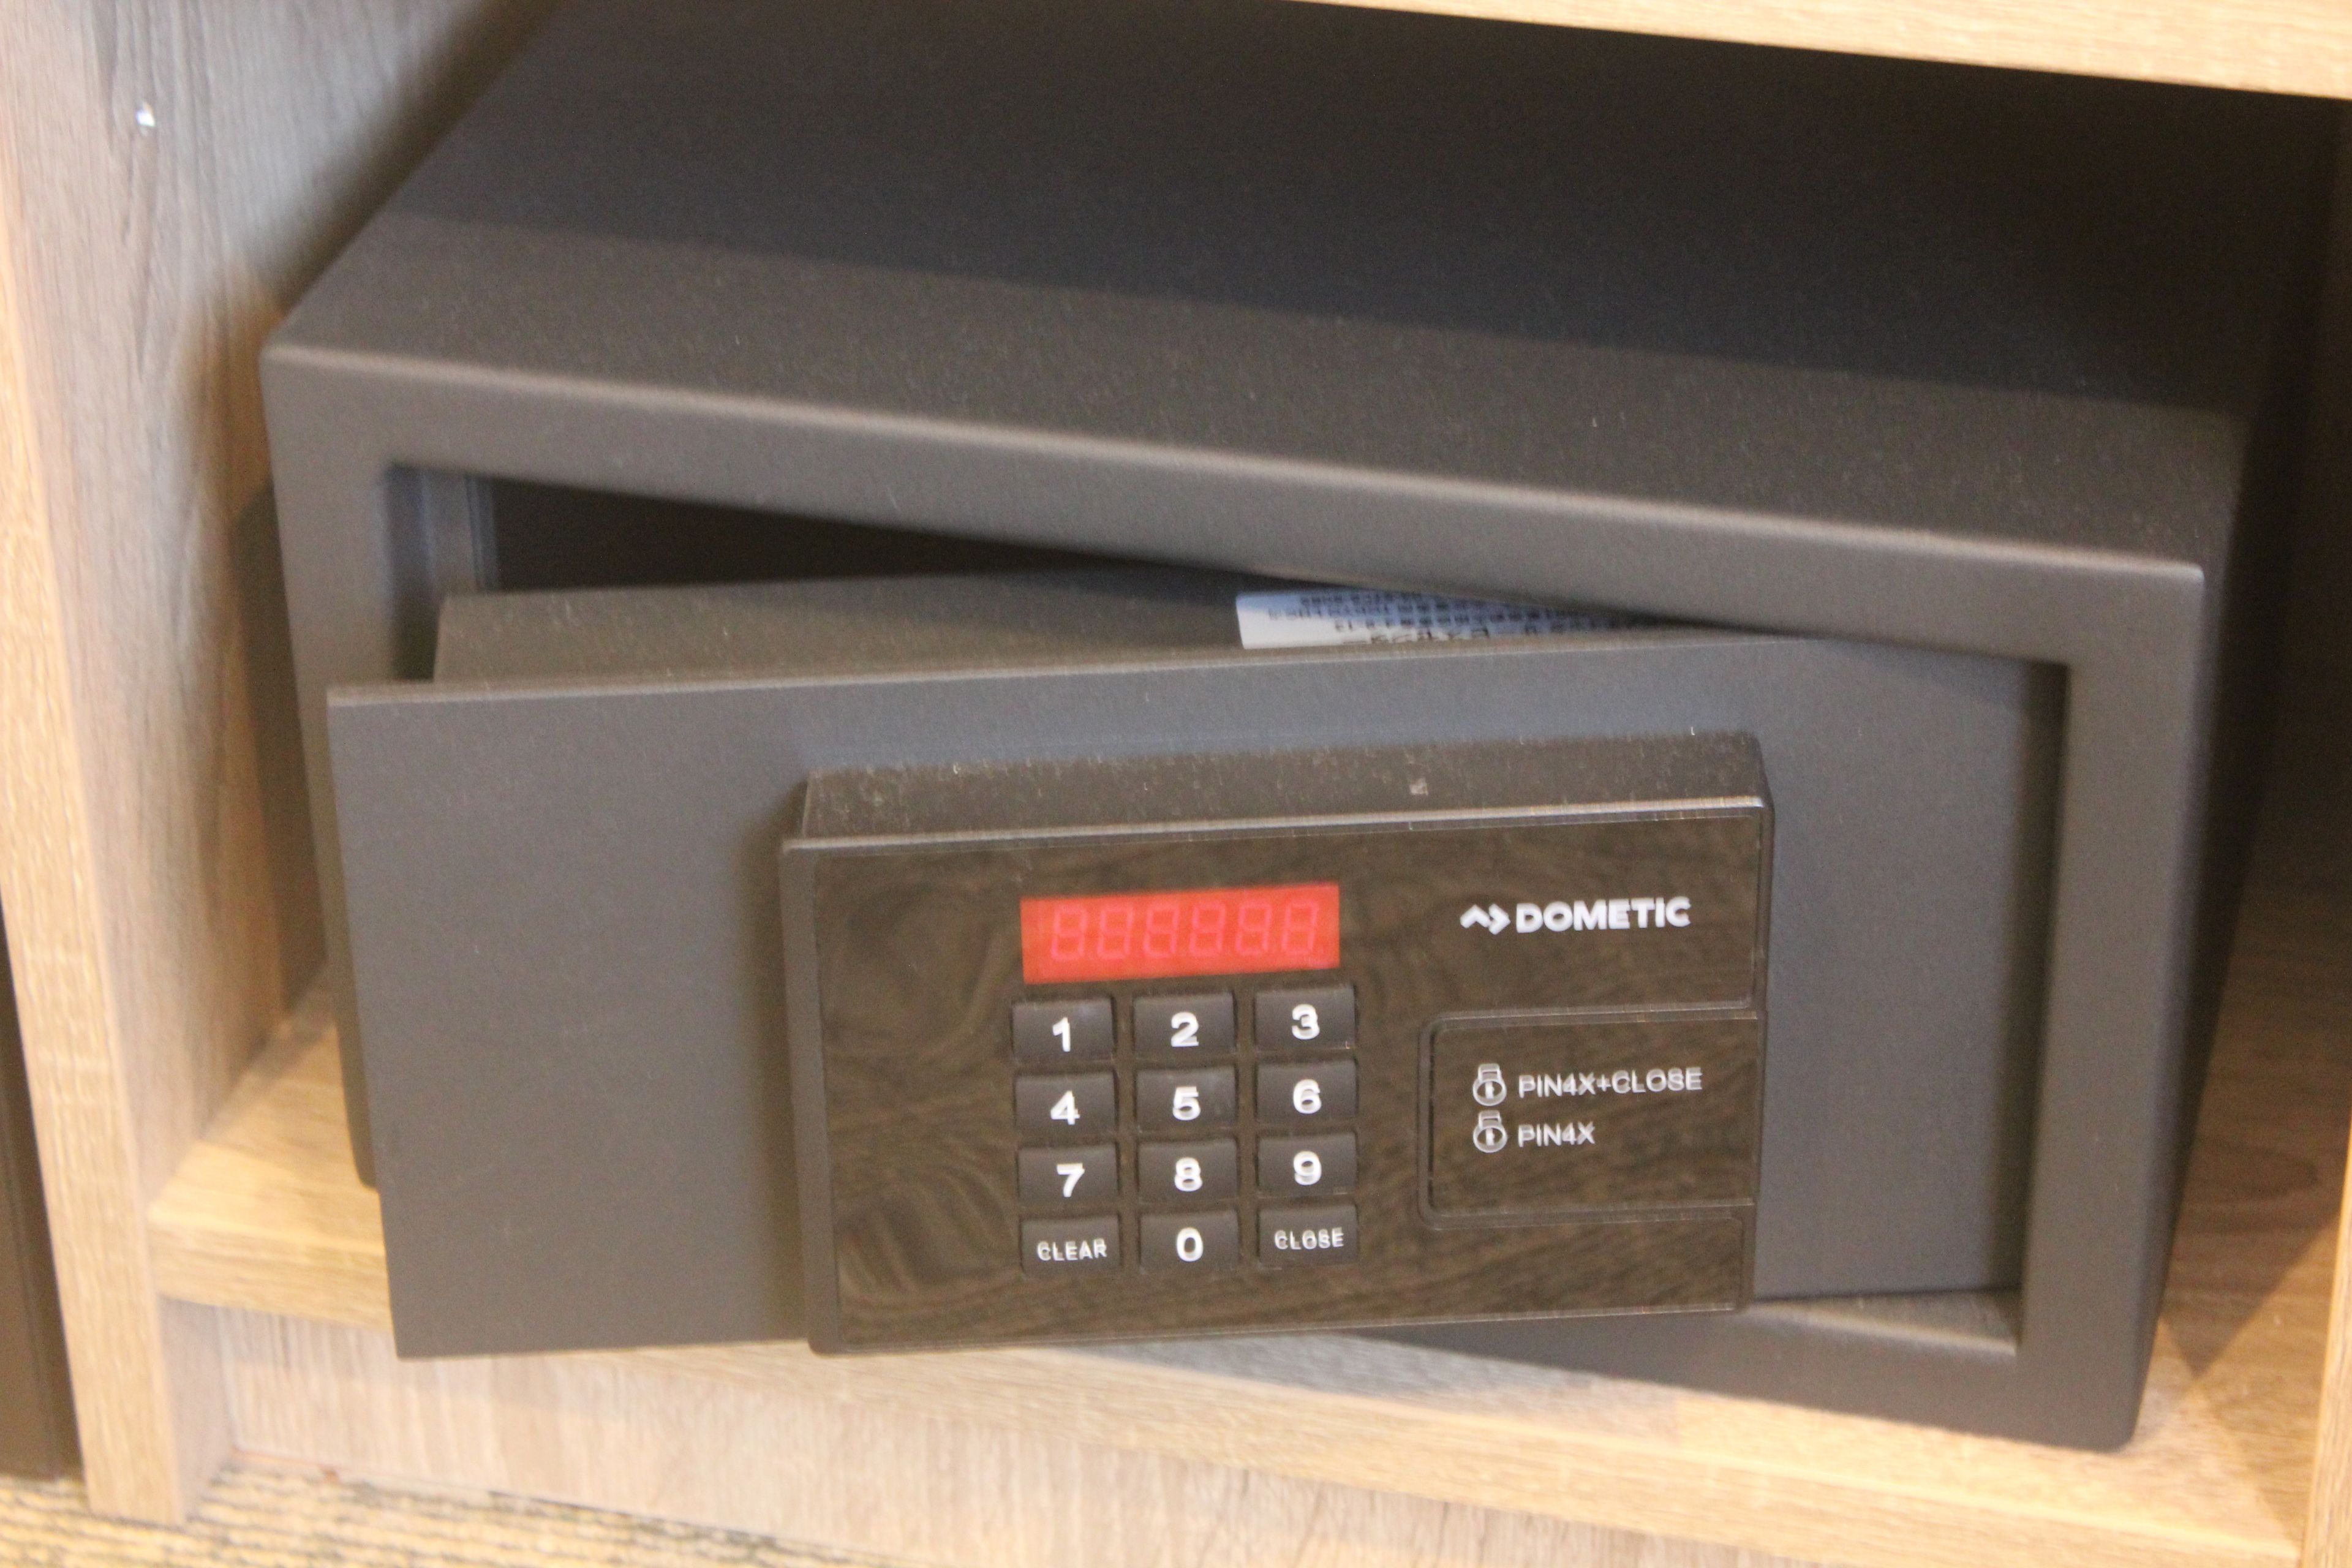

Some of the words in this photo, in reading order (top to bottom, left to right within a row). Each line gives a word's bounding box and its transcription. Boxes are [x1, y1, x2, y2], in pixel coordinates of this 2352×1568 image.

[1515, 897, 1691, 933] DOMETIC
[1052, 1017, 1071, 1052] 1
[1170, 1011, 1199, 1047] 2
[1292, 1004, 1320, 1039] 3
[1292, 1079, 1322, 1114] 6
[1518, 1068, 1703, 1098] PIN4X+CLOSE
[1050, 1091, 1080, 1125] 4
[1172, 1086, 1200, 1121] 5
[1518, 1122, 1595, 1148] PIN4X
[1056, 1163, 1085, 1197] 7
[1174, 1157, 1202, 1192] 8
[1293, 1151, 1322, 1185] 9
[1037, 1238, 1107, 1261] CLEAR
[1176, 1227, 1204, 1262] 0
[1274, 1228, 1344, 1250] CLOSE
